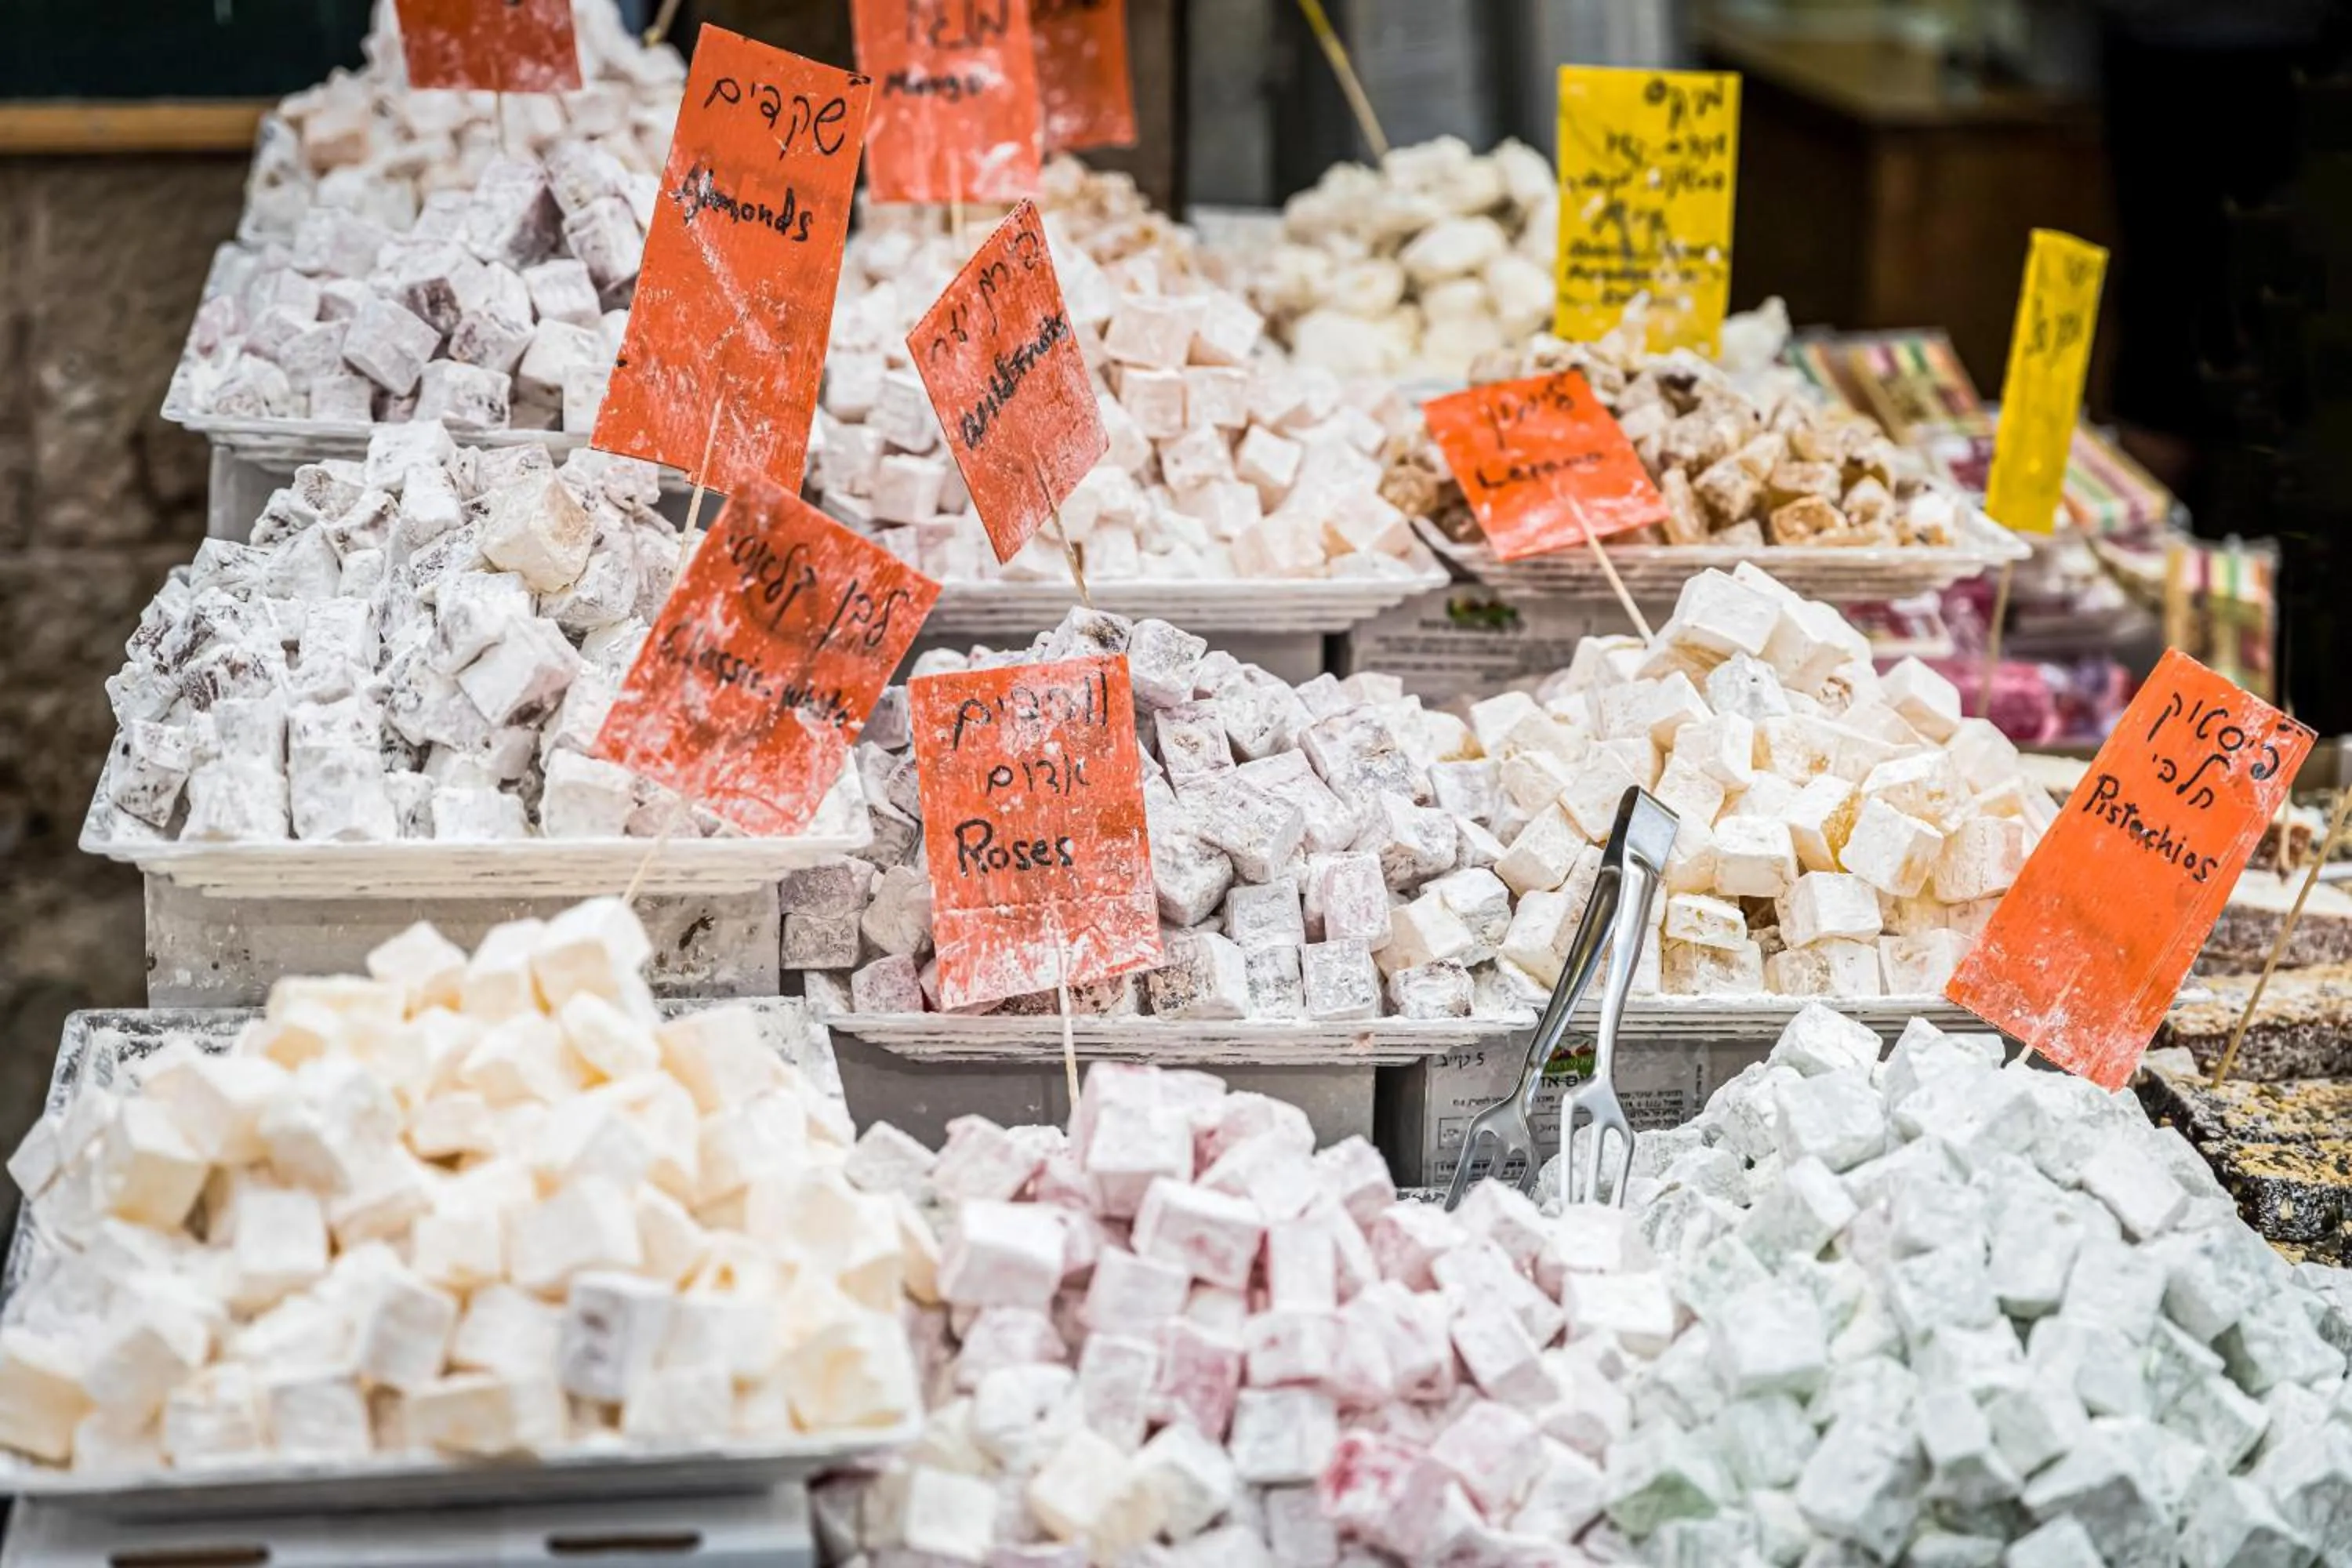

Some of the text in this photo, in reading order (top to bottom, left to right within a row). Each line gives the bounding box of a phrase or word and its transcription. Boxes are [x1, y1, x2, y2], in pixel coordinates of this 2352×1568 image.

[702, 77, 846, 161] שקדים
[2147, 691, 2281, 780] פיסטוק
[2151, 754, 2230, 810] חלבי
[953, 818, 1075, 877] Roses
[2083, 772, 2219, 884] Pistachios
